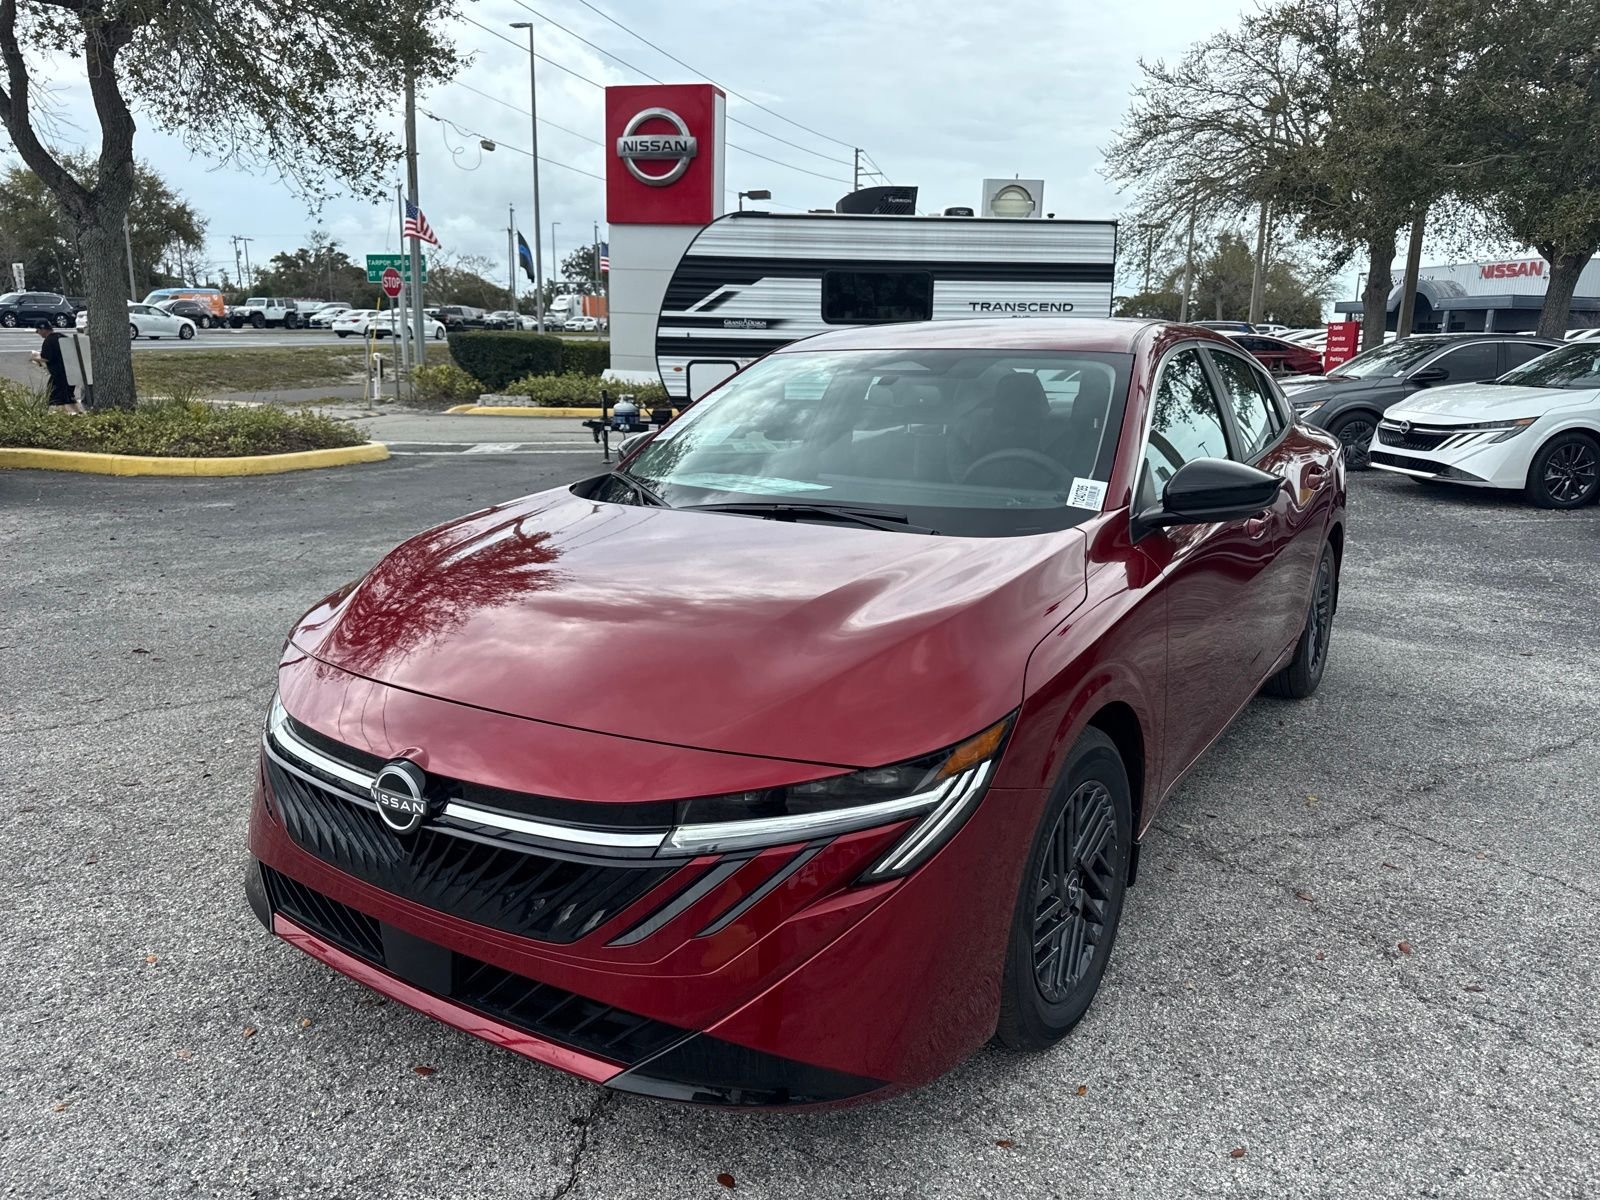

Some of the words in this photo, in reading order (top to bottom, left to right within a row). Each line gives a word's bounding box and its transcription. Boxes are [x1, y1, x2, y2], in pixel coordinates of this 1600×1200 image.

[622, 140, 688, 152] NISSAN
[1481, 262, 1543, 279] NISSAN
[383, 276, 401, 288] STOP
[969, 302, 1074, 312] TRANSCEND
[371, 788, 424, 813] NISSAN
